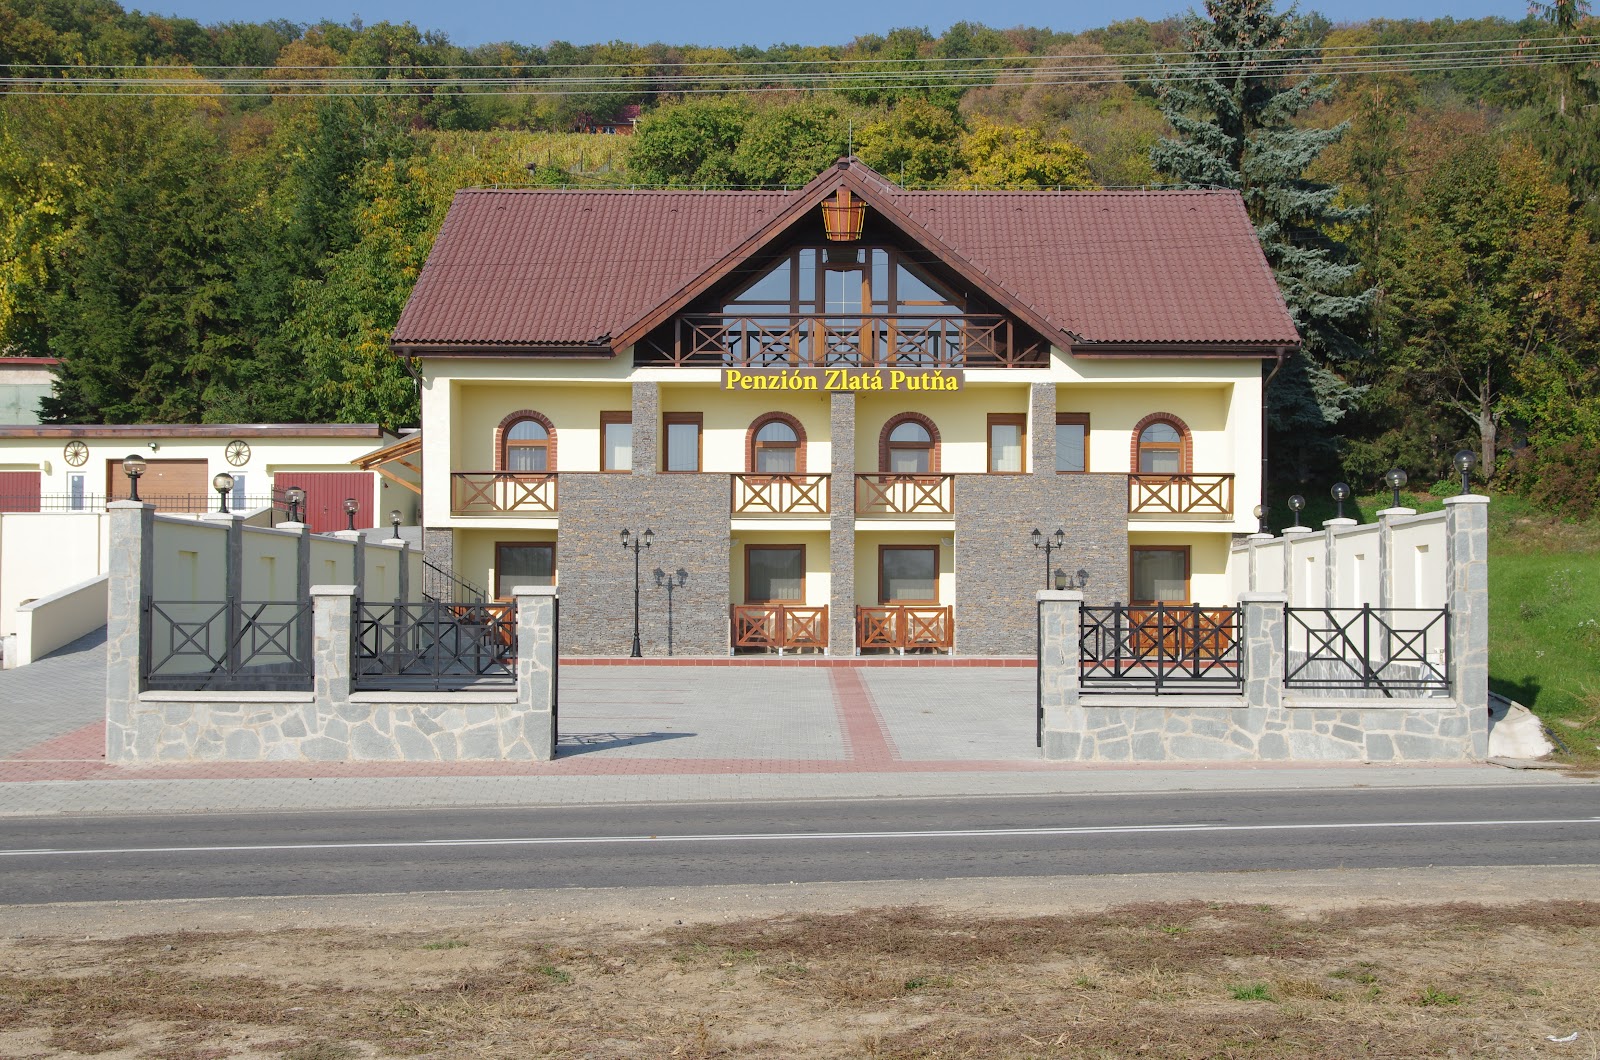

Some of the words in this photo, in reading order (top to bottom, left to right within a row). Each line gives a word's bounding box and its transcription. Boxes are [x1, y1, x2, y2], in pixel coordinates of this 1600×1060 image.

[725, 369, 818, 390] Penzión
[823, 369, 883, 390] Zlatá
[889, 369, 959, 391] Putňa
